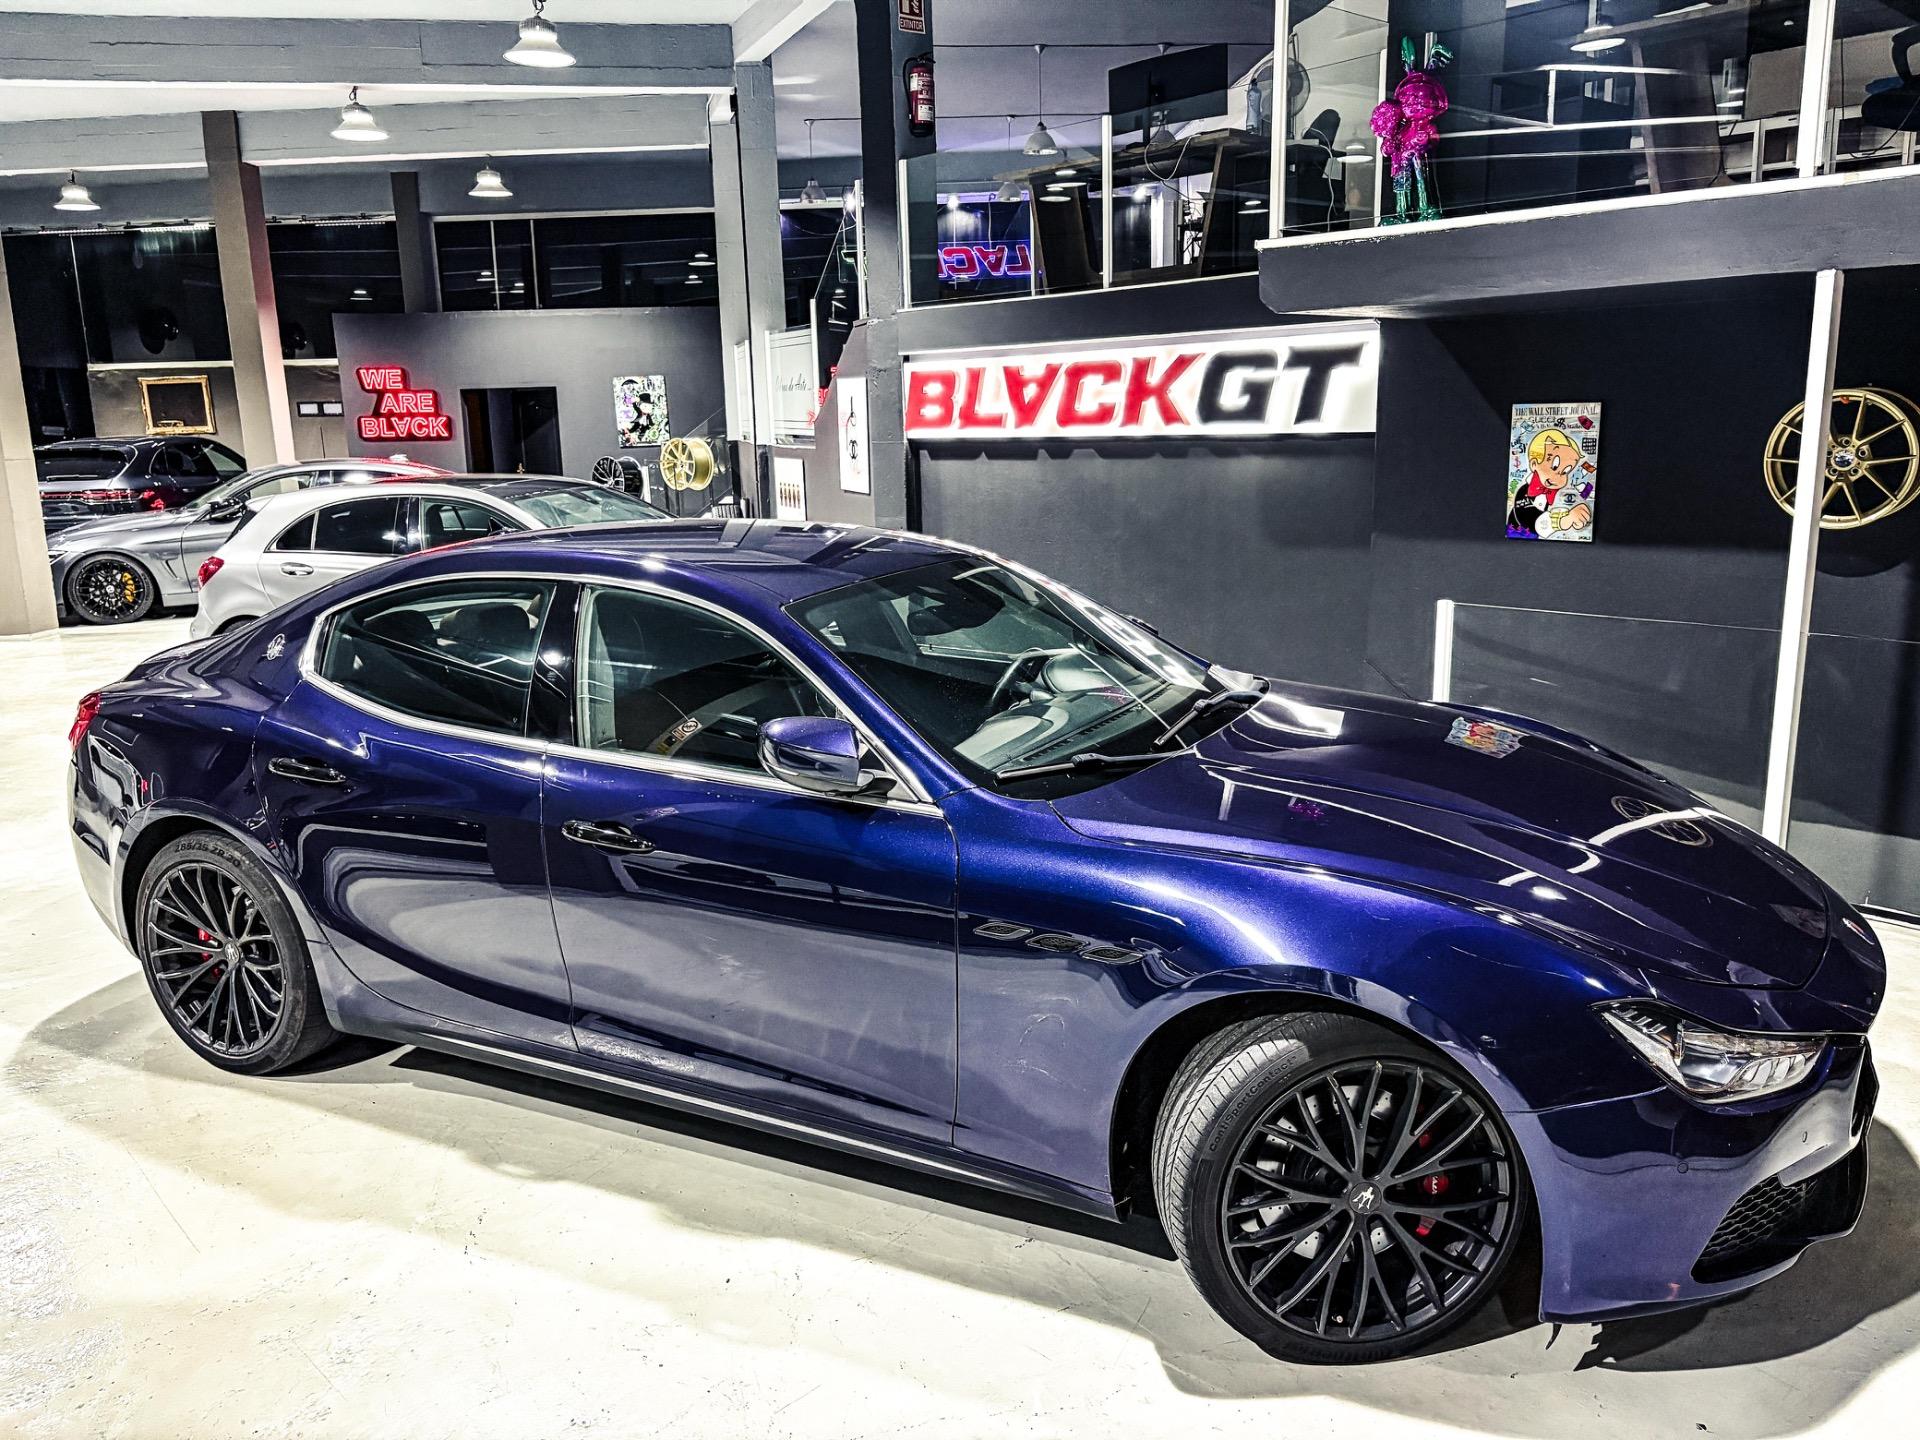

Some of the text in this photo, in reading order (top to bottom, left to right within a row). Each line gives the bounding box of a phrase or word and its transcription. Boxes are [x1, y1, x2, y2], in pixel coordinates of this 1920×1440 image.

[900, 19, 923, 31] EXTINTOR
[359, 369, 404, 390] WE
[380, 392, 435, 413] ARE
[1528, 407, 1546, 416] WALL
[1546, 406, 1569, 416] STREET
[1570, 405, 1599, 415] JOURNAL
